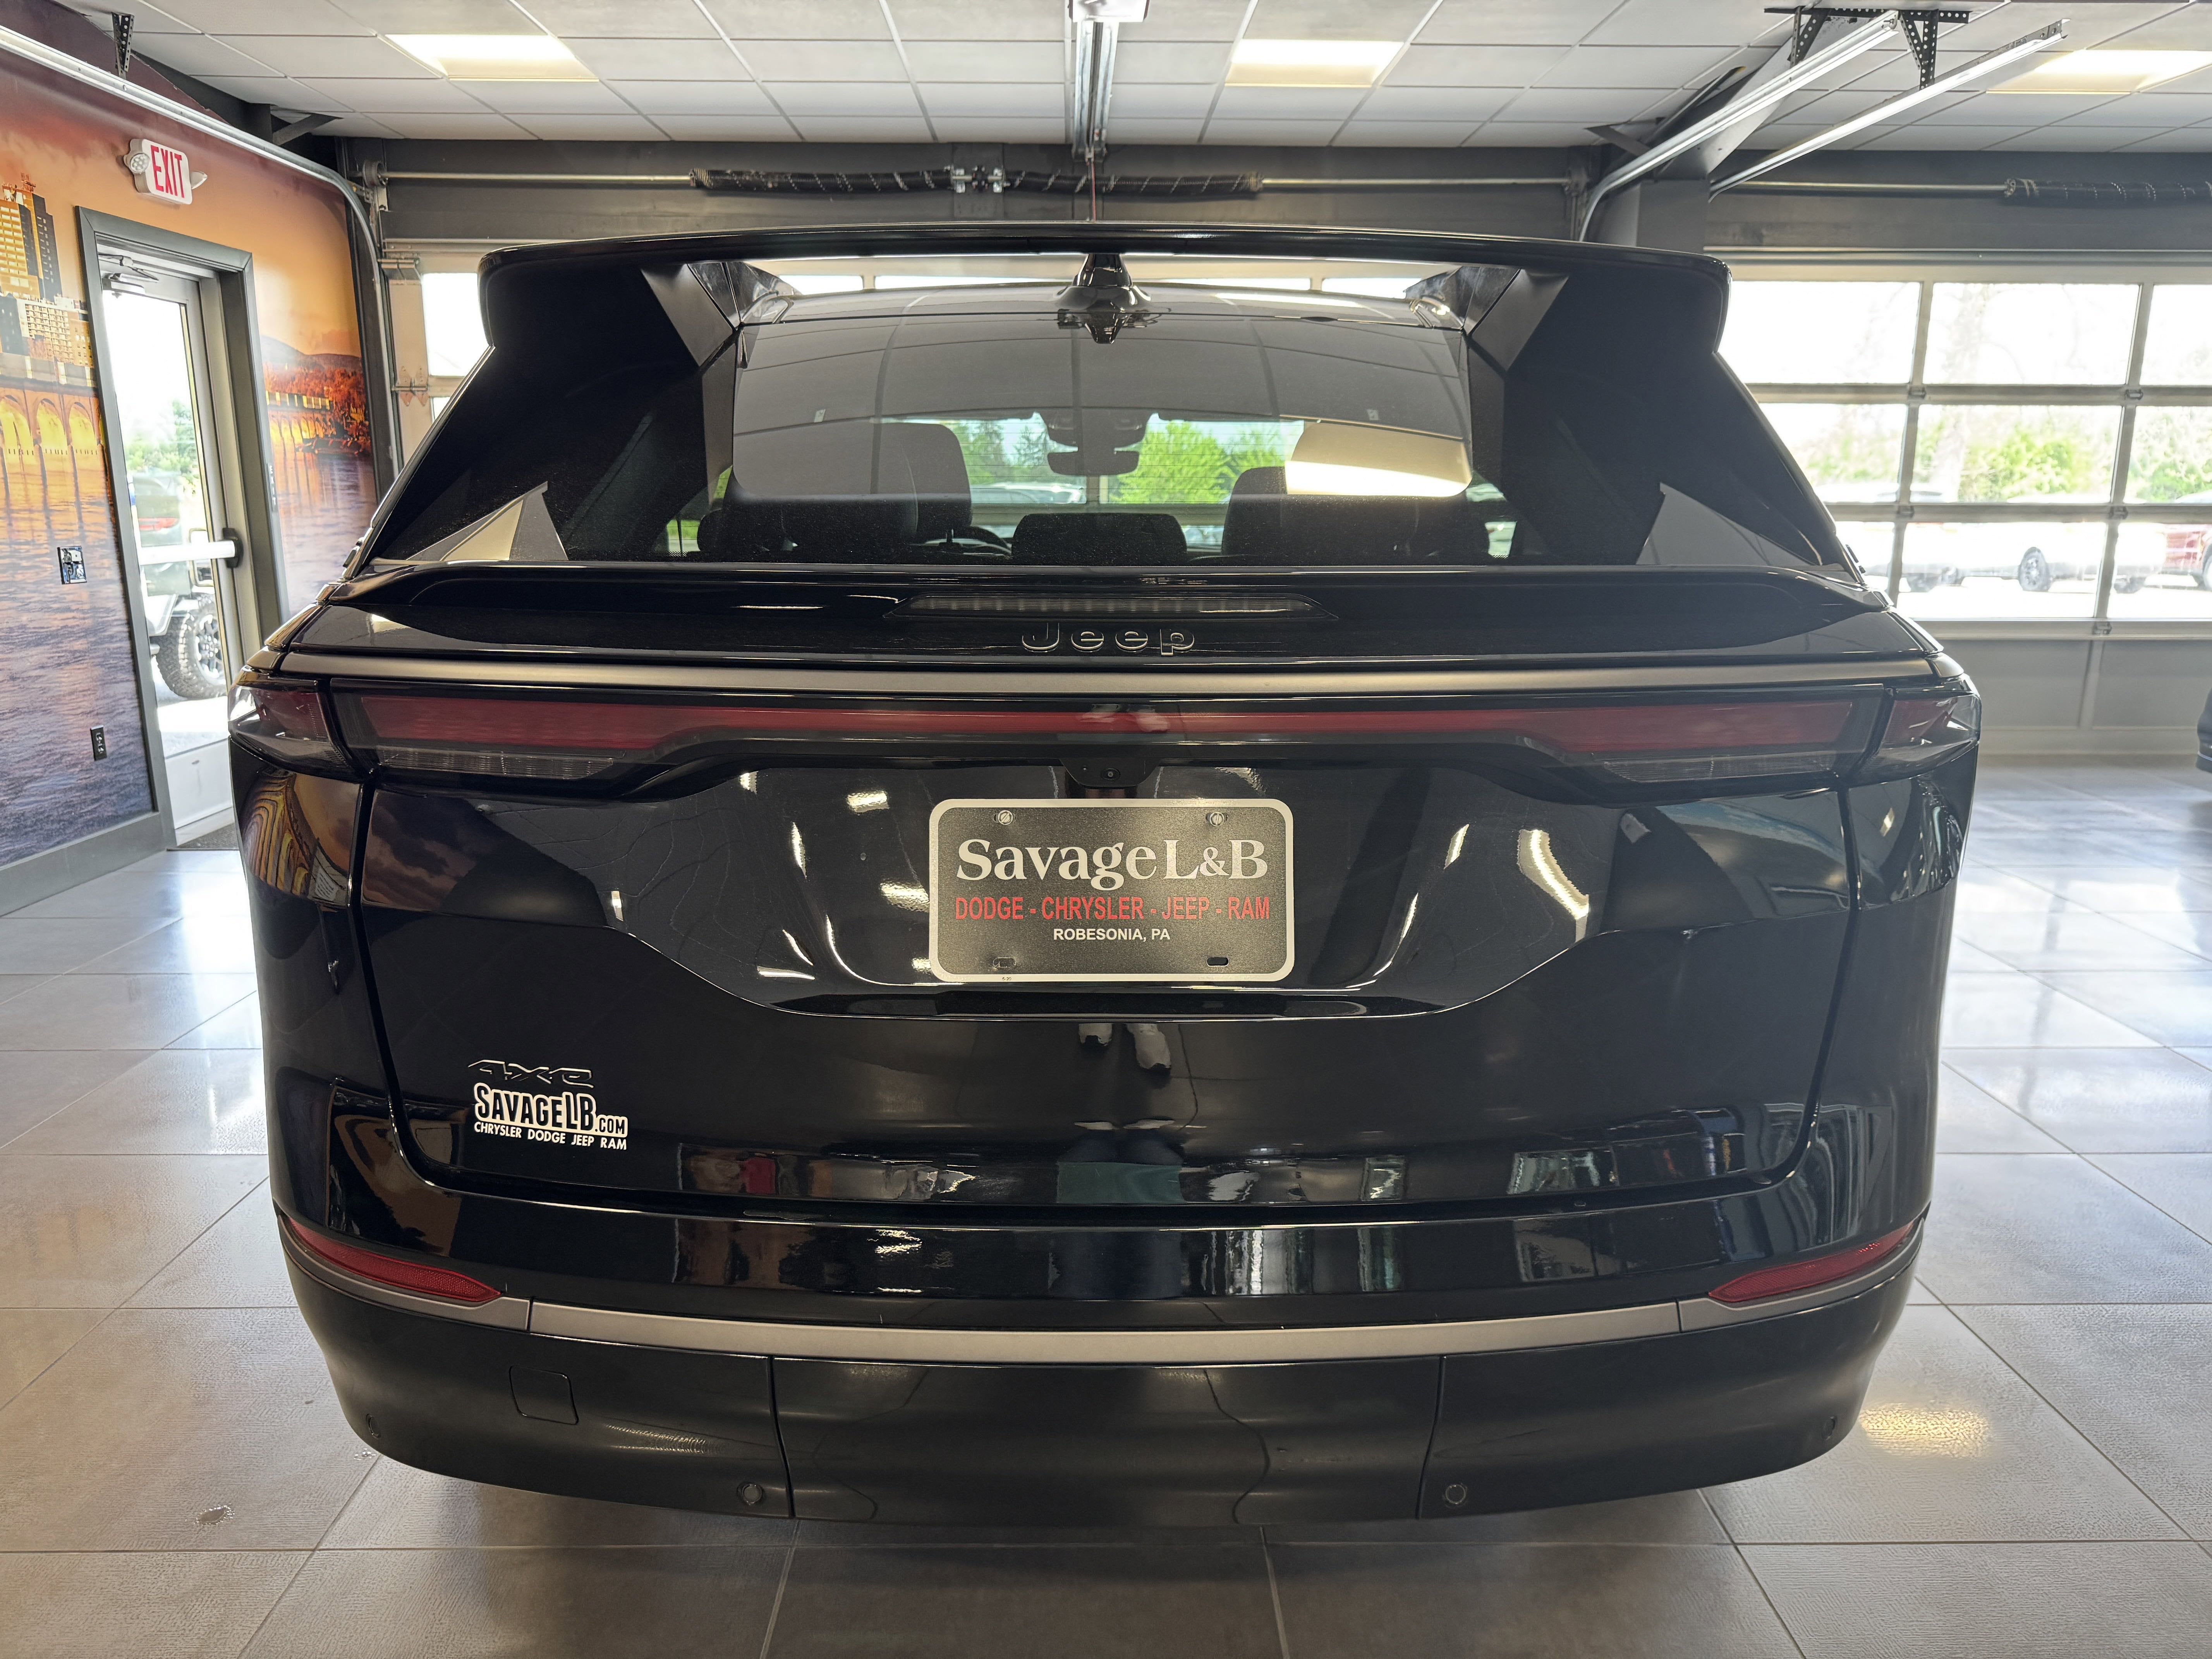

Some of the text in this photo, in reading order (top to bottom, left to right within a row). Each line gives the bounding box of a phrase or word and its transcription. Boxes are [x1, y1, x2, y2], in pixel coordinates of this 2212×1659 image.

[150, 145, 185, 198] EXIT
[1022, 622, 1195, 656] Jeep
[955, 897, 1024, 920] DODGE
[1042, 896, 1144, 920] CHRYSLER
[1162, 896, 1210, 920] JEEP
[1228, 897, 1269, 920] RAM
[1053, 928, 1171, 942] ROBESONIA, PA
[474, 1121, 627, 1150] CHRYSLER DODGE JEEP RAM
